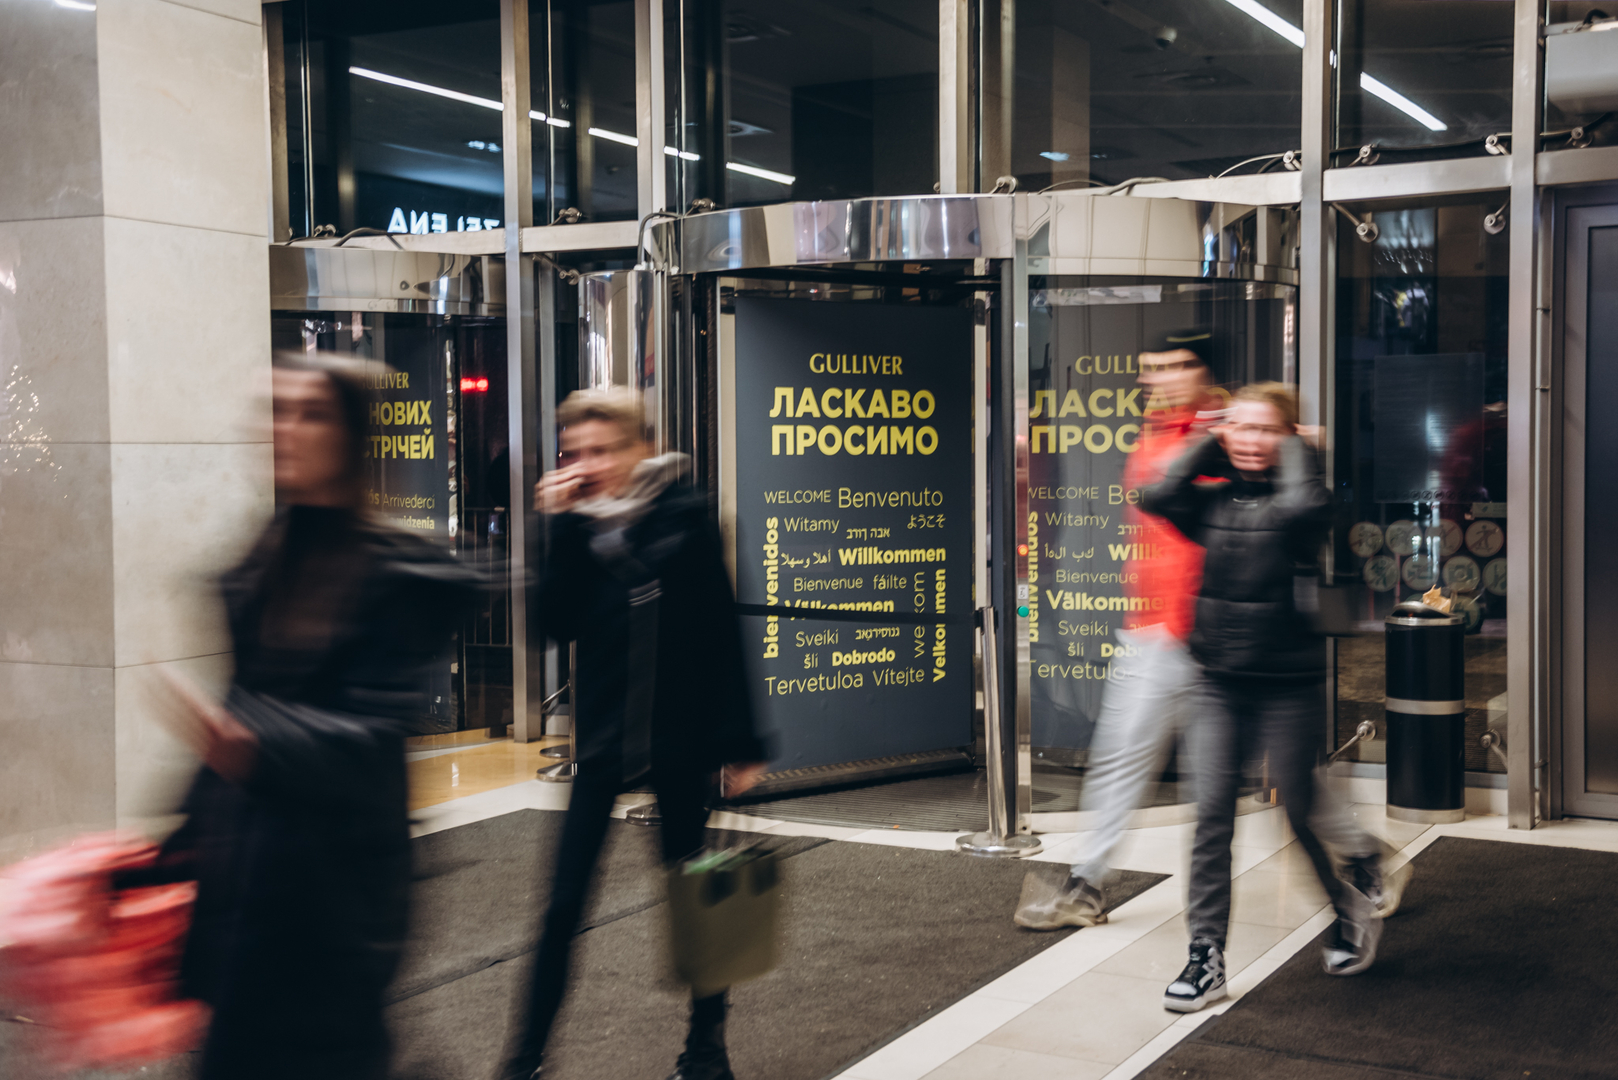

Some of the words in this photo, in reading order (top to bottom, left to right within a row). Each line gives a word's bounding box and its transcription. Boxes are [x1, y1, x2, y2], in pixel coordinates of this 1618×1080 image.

[809, 352, 903, 375] GULLIVER
[363, 371, 410, 389] ULLIVER
[368, 400, 432, 425] НОВИХ
[769, 386, 936, 419] ЛАСКАВО
[771, 424, 939, 456] ПРОСИМО
[764, 489, 832, 504] WELCOME
[838, 486, 943, 509] Benvenuto
[783, 516, 840, 534] Witamy
[907, 513, 946, 530] ようこそ
[1044, 511, 1110, 530] Witamy
[838, 546, 946, 566] Willkommen
[793, 576, 863, 593] Bienvenue
[873, 573, 907, 590] fáilte
[1056, 568, 1139, 584] Bienvenue
[1045, 589, 1164, 611] Välkomme
[795, 628, 839, 648] Sveiki
[1058, 620, 1109, 636] Sveiki
[803, 652, 819, 670] šli
[832, 646, 896, 667] Dobrodo
[1067, 641, 1084, 657] šli
[764, 669, 864, 696] Tervetuloa
[872, 666, 925, 687] Vítejte
